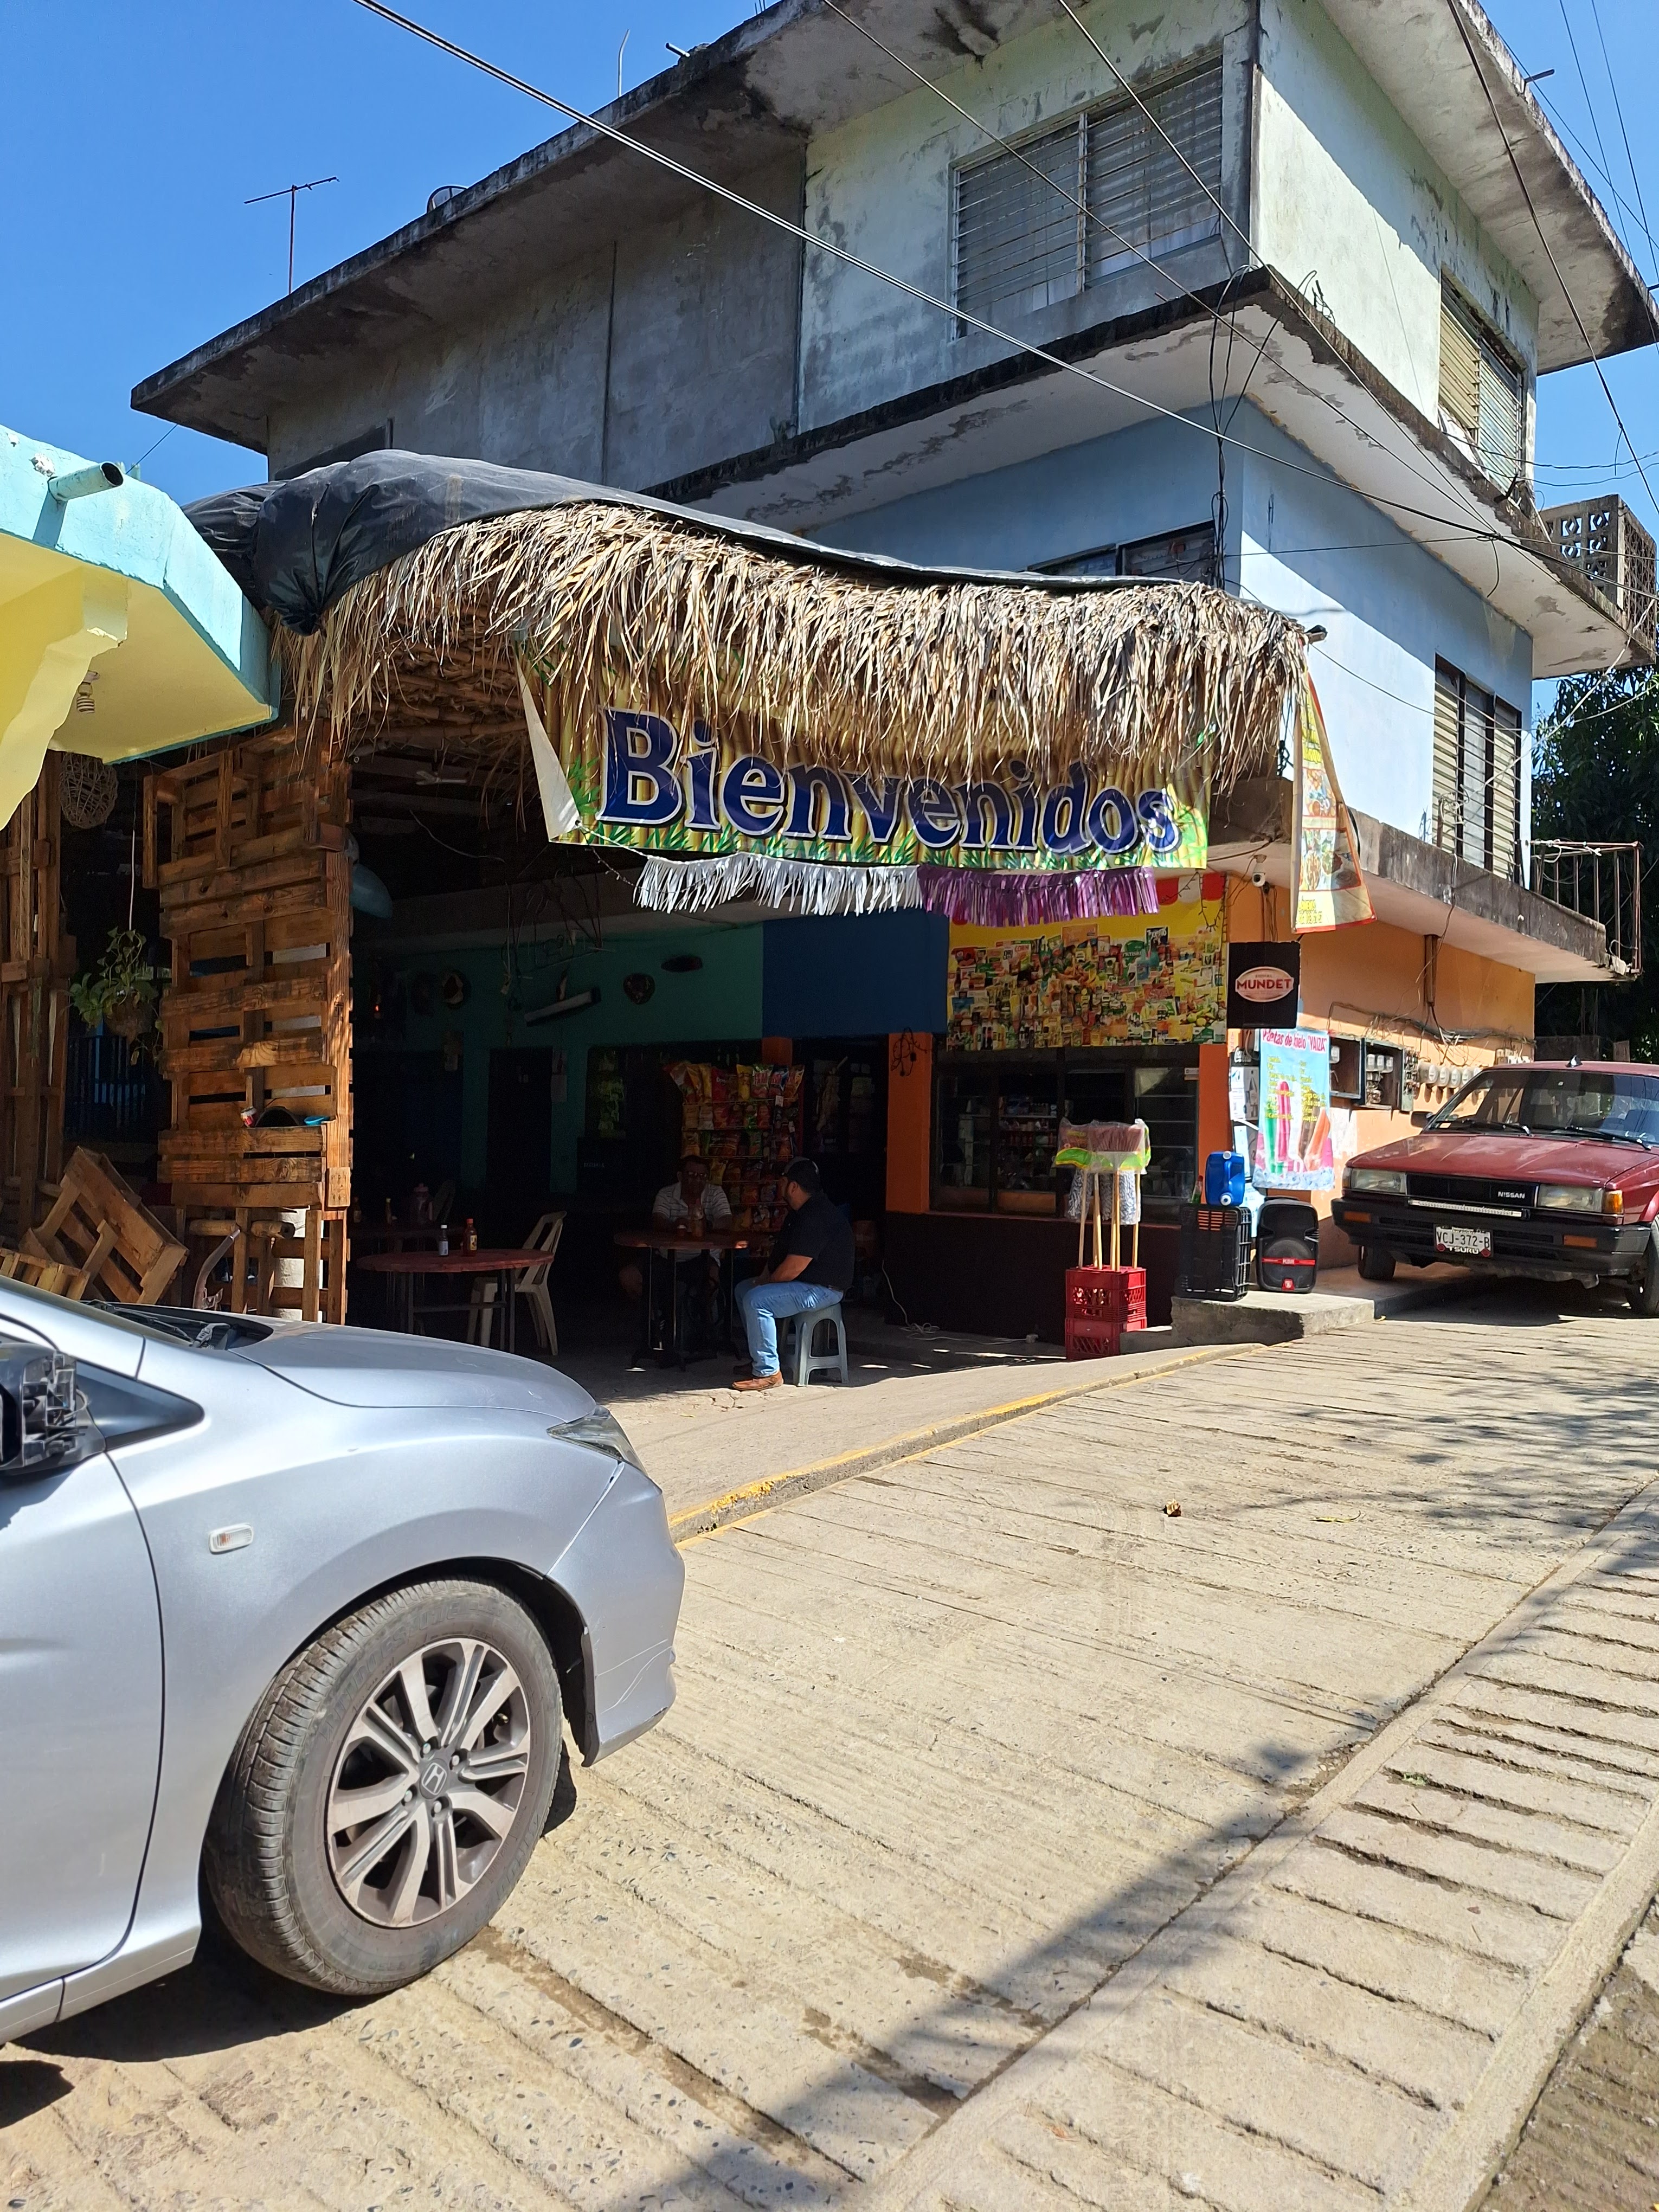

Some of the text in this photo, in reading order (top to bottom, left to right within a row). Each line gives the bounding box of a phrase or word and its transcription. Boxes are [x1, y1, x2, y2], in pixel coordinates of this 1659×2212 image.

[598, 708, 1185, 857] Bienvenidos
[1237, 979, 1292, 990] MUNDET
[1285, 1032, 1293, 1046] de
[1294, 1032, 1307, 1049] hielo
[1437, 1231, 1490, 1249] VCJ-372-B
[1449, 1246, 1479, 1255] TSURU
